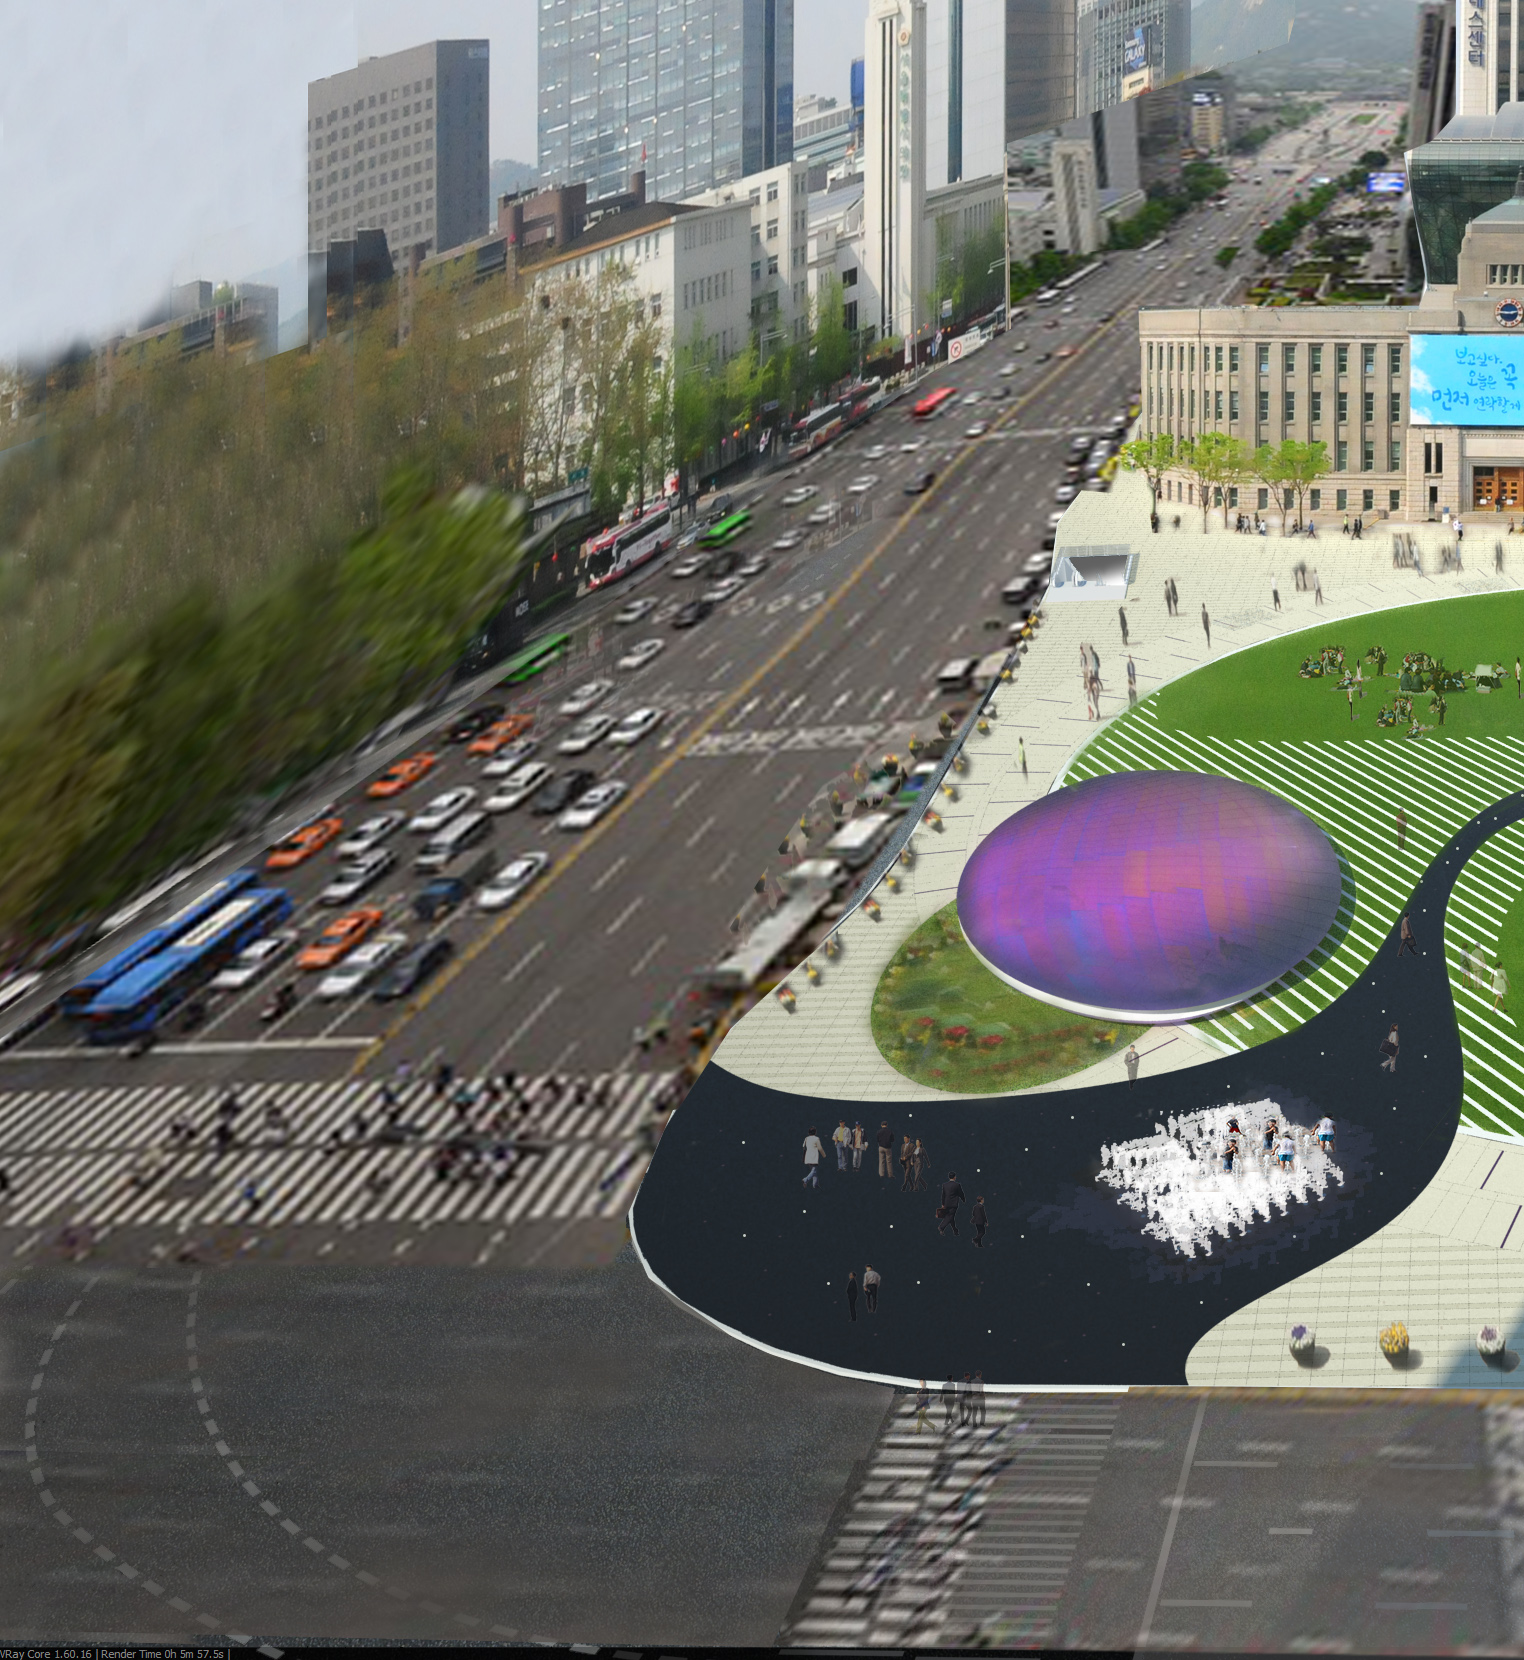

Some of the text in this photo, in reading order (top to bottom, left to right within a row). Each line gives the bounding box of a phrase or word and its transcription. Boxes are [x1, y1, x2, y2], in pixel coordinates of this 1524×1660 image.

[1455, 346, 1503, 367] 보고싶다.
[1467, 362, 1518, 391] 오늘은 꼭
[1432, 387, 1521, 414] 먼저 연락할게
